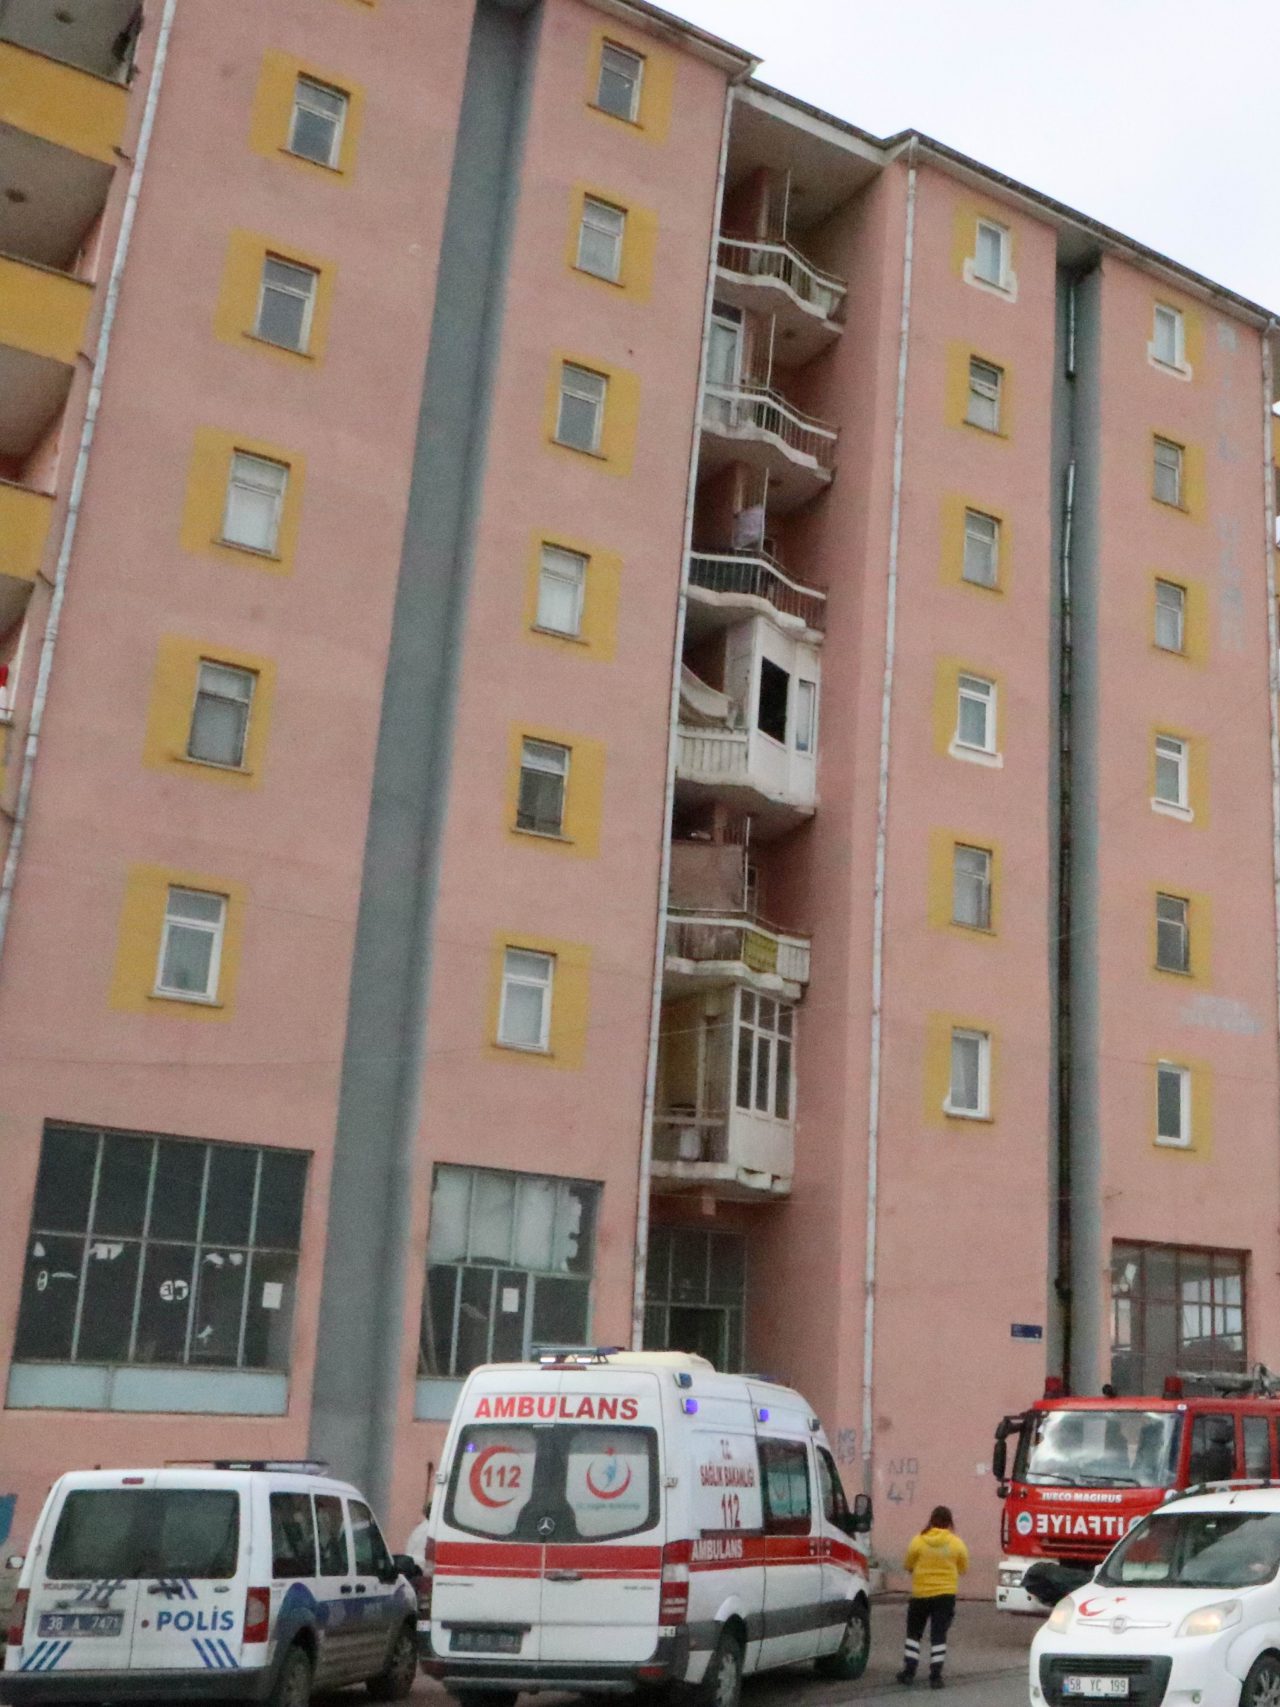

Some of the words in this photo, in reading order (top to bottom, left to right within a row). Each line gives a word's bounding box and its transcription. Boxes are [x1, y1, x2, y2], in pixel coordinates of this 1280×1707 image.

[475, 1396, 639, 1420] AMBULANS
[484, 1465, 521, 1488] 112
[1042, 1492, 1071, 1501] IVECO
[1073, 1493, 1122, 1503] MAGIRUS
[721, 1493, 741, 1528] 112
[691, 1539, 743, 1561] AMBULANS
[48, 1616, 63, 1631] 38
[156, 1606, 234, 1632] POLİS
